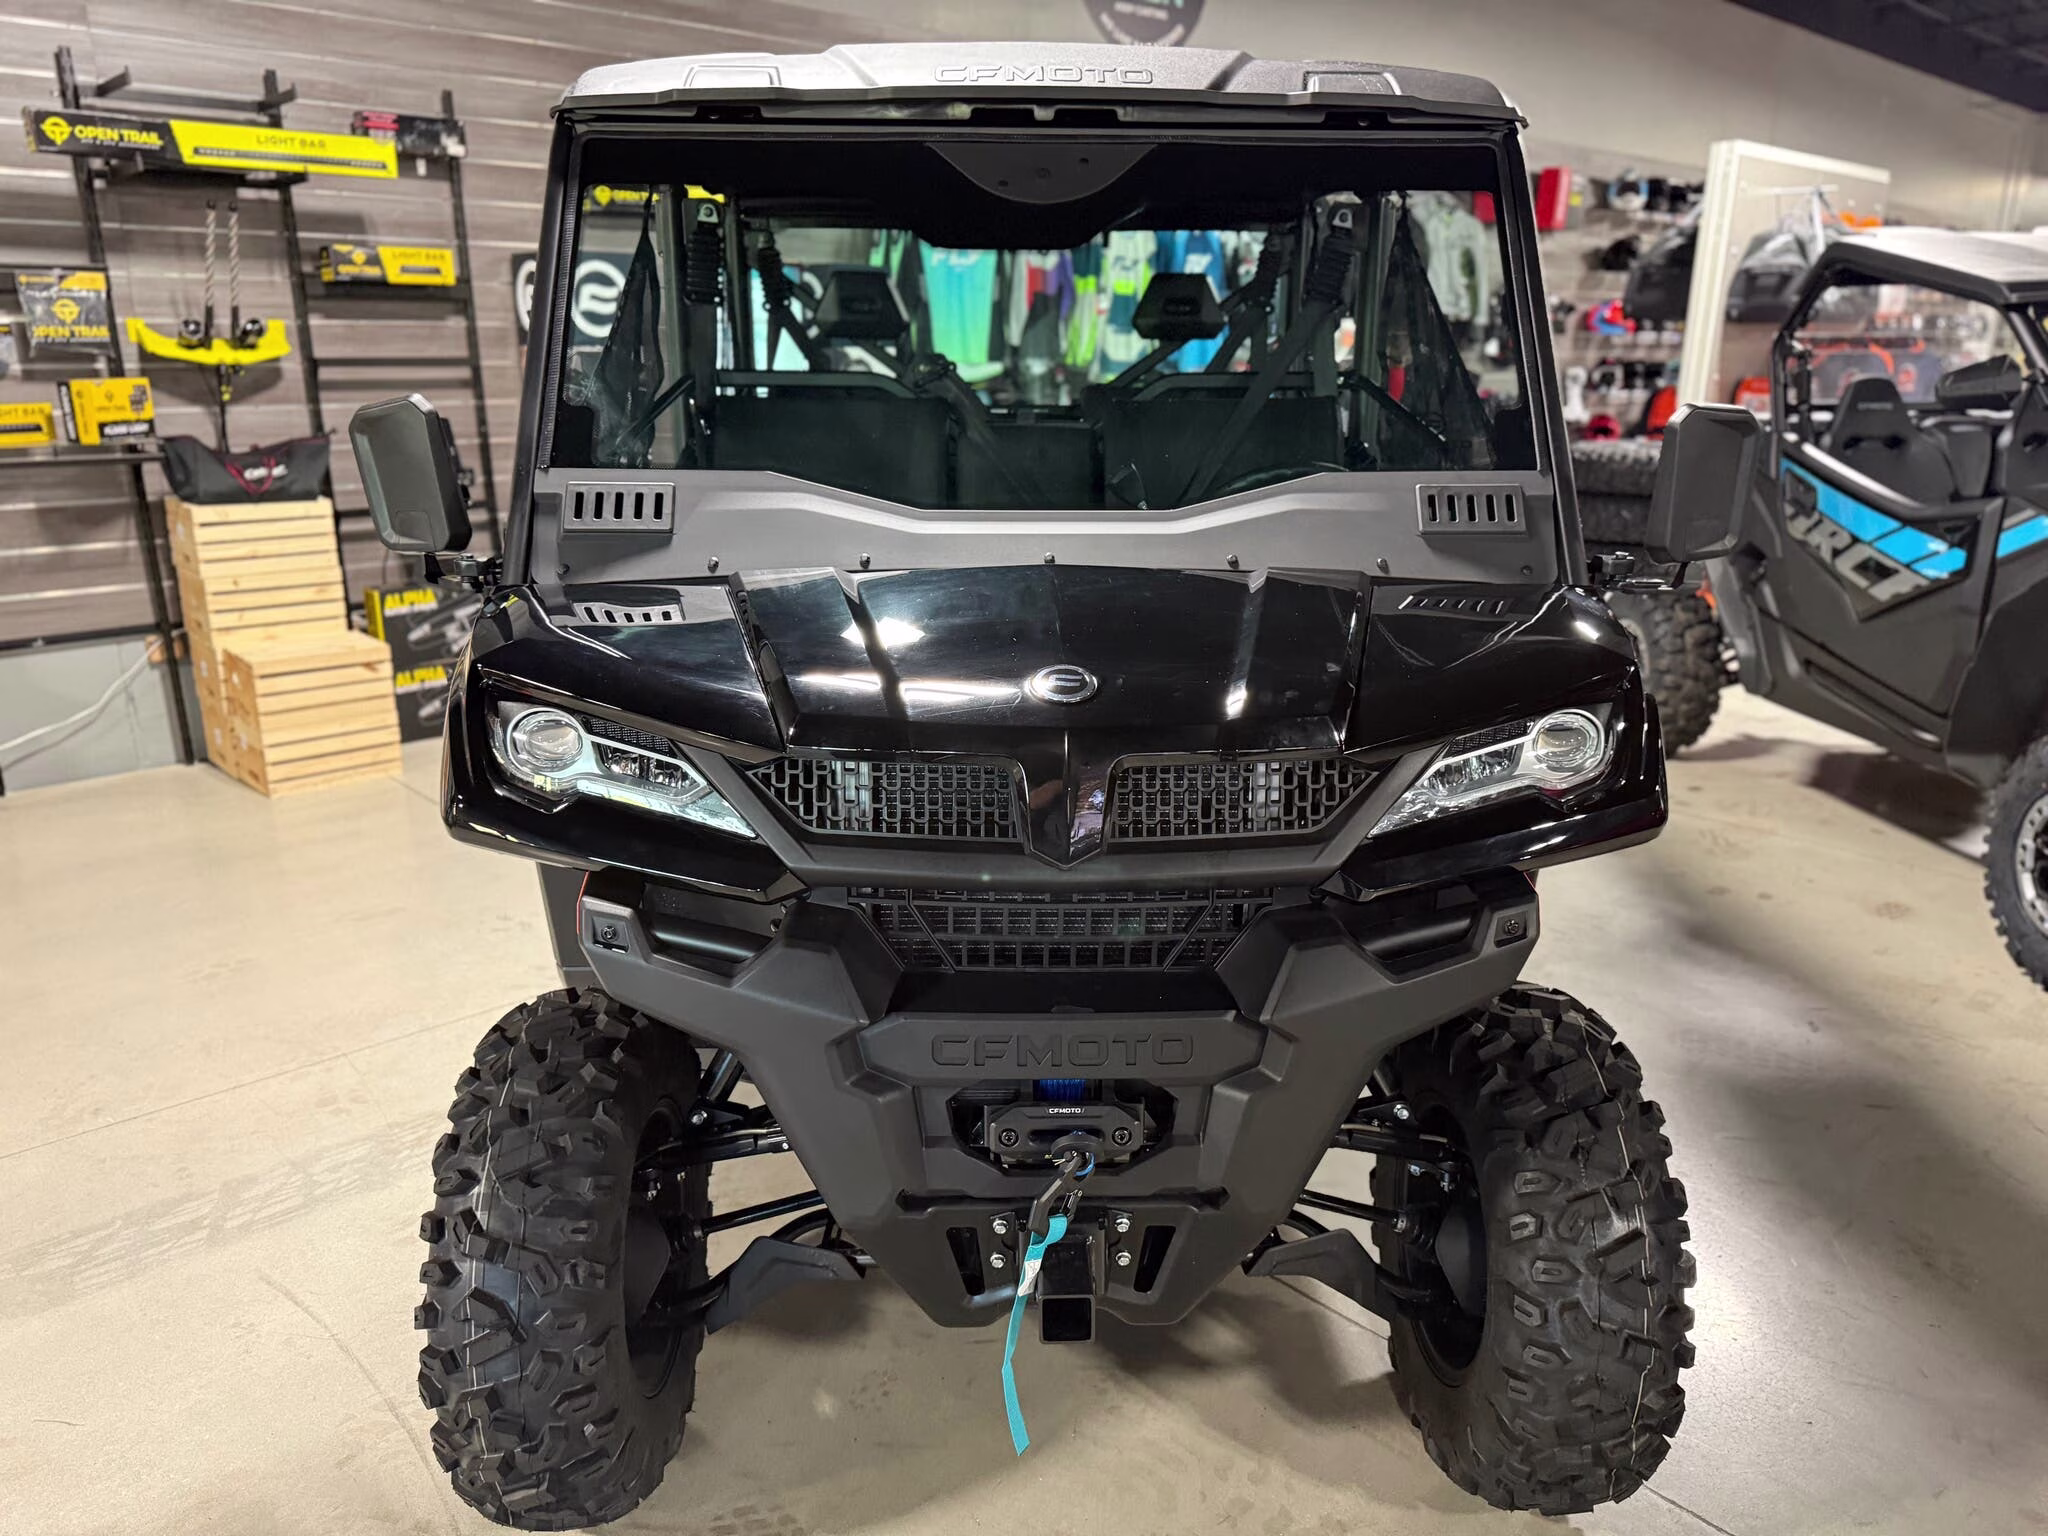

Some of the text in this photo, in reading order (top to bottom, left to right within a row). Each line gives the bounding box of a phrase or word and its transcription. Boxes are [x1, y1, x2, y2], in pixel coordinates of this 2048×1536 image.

[933, 65, 1153, 84] CFMOTO
[73, 124, 119, 141] OPEN
[119, 129, 164, 146] TRAIL
[256, 134, 326, 149] LIGHT BAR
[931, 1033, 1194, 1067] CFMOTO
